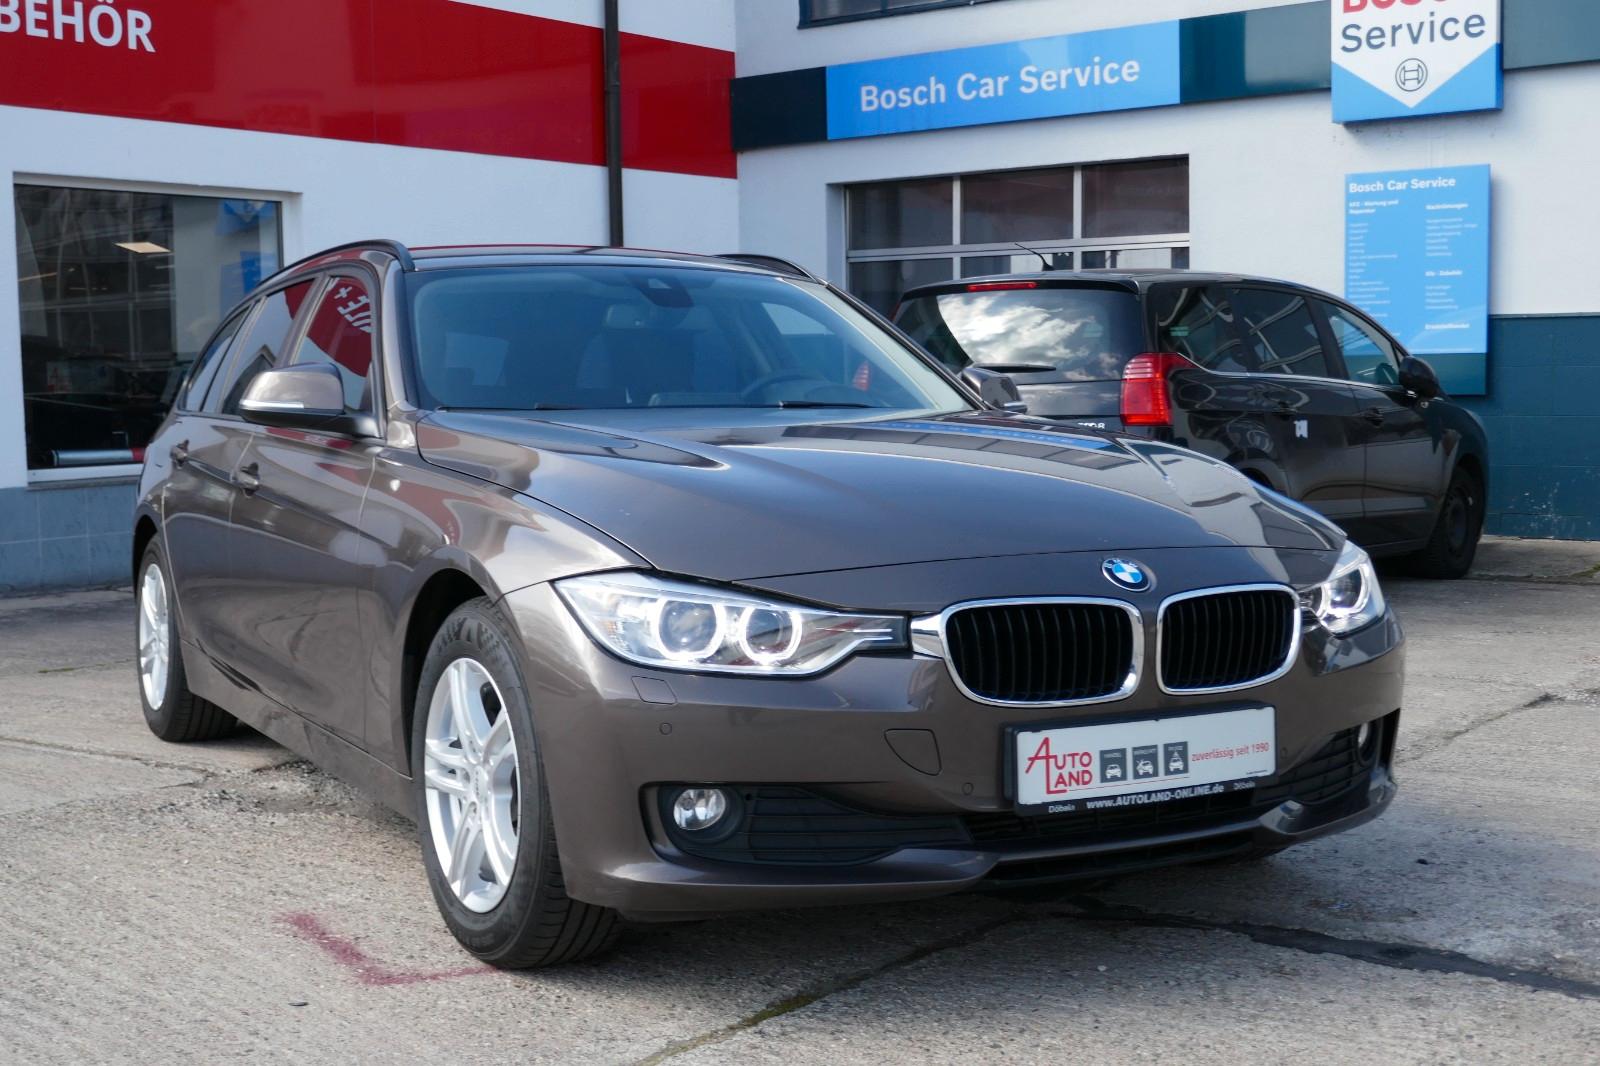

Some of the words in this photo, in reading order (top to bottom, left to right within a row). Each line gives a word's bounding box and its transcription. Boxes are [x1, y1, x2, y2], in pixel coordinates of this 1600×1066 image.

[1341, 11, 1486, 53] Service
[860, 76, 946, 112] Bosch
[957, 72, 1009, 101] Car
[1019, 56, 1140, 94] Service
[1349, 181, 1384, 193] Bosch
[1387, 179, 1408, 191] Car
[1410, 177, 1456, 189] Service
[1236, 746, 1249, 756] seit
[1251, 742, 1269, 753] 1990
